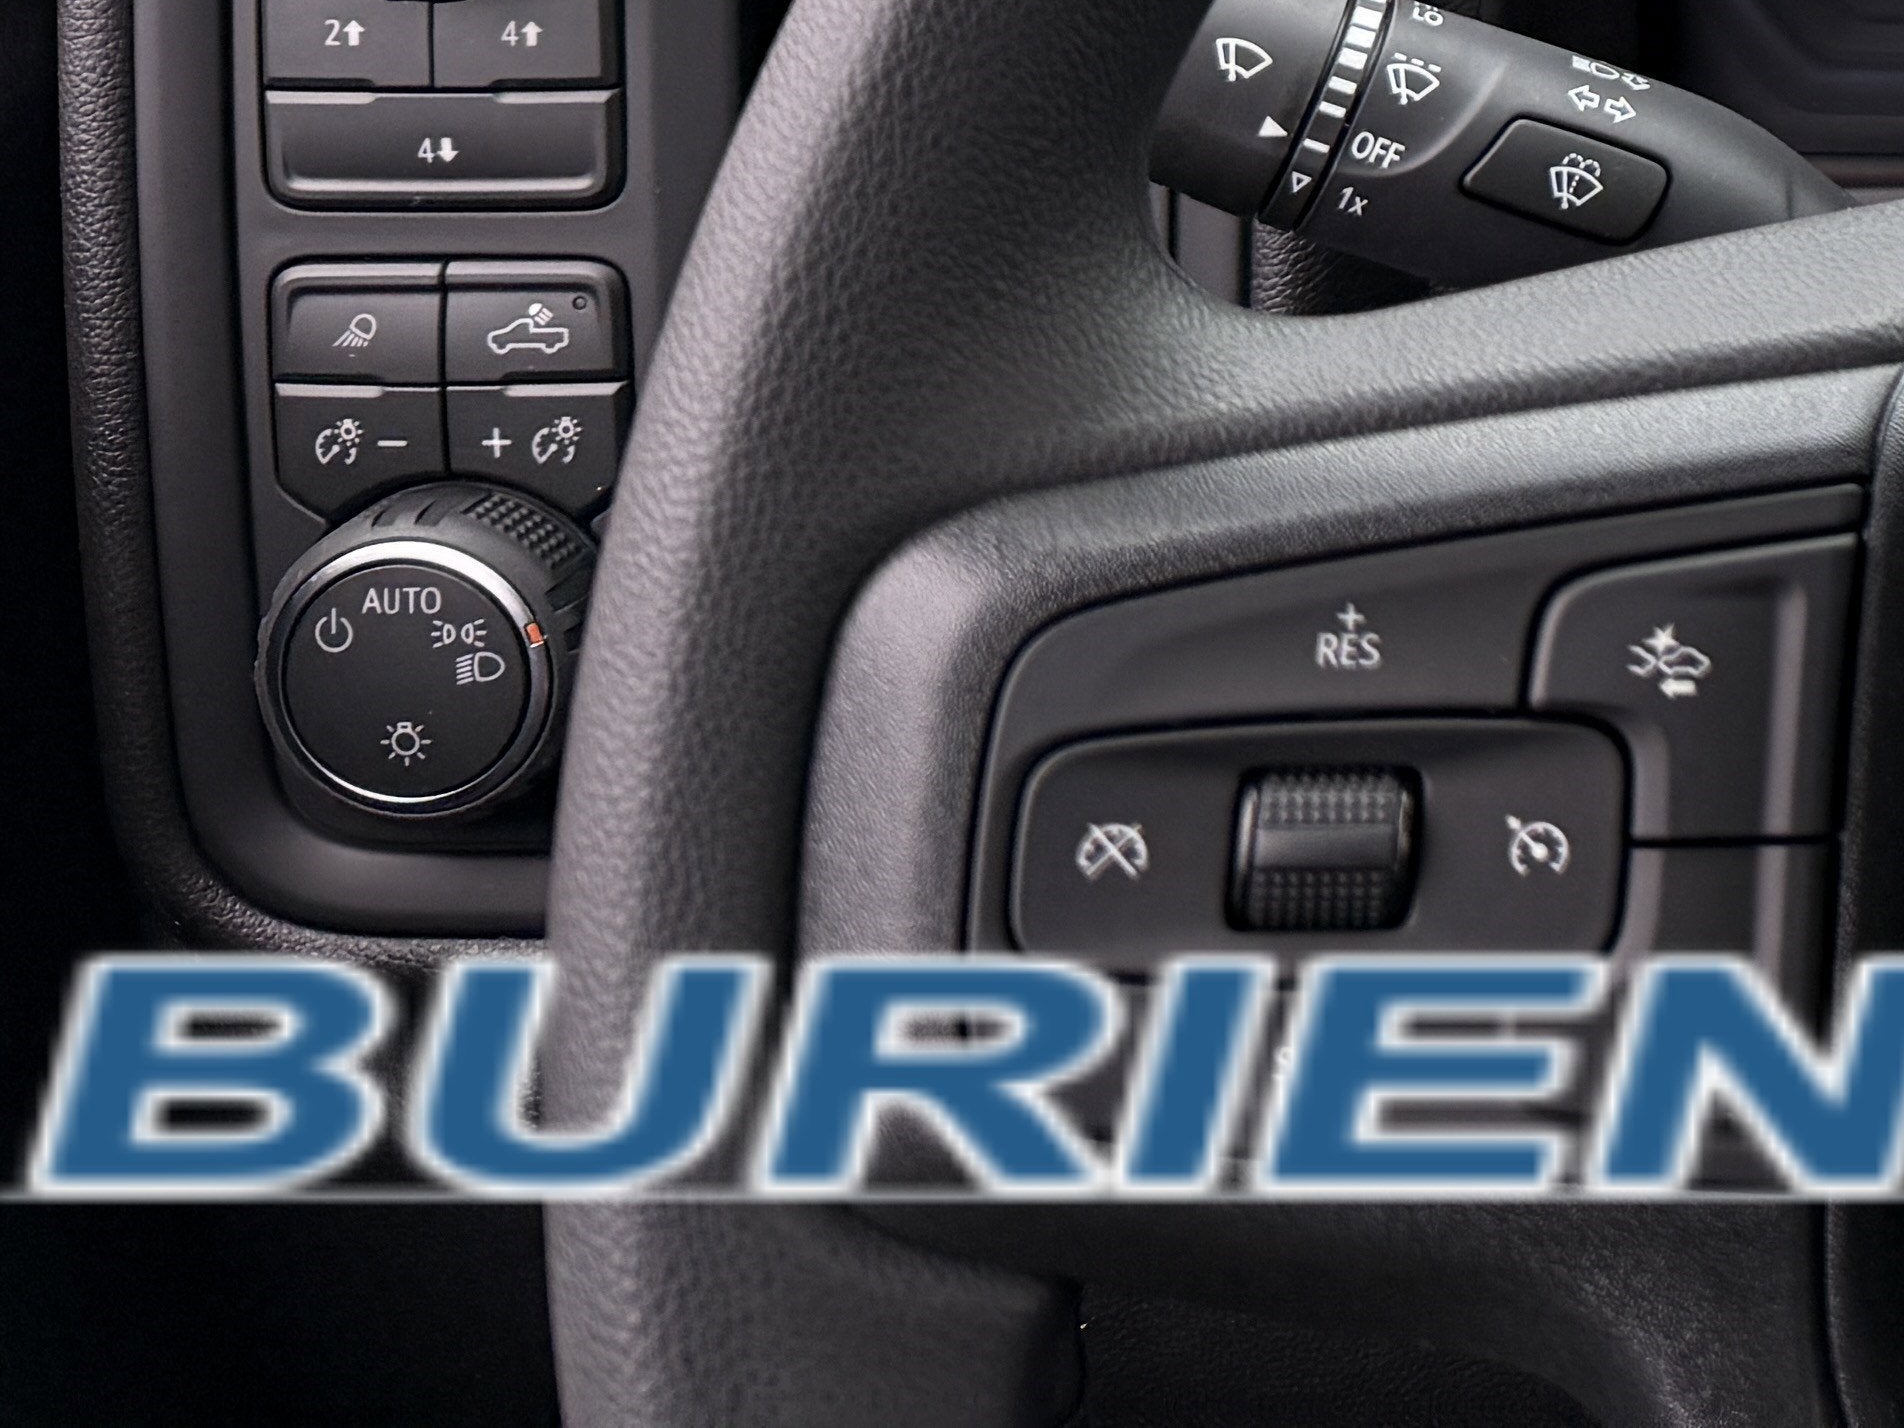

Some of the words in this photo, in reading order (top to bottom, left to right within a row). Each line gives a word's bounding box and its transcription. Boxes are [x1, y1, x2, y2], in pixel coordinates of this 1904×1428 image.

[325, 20, 340, 46] 2
[501, 21, 518, 46] 4
[418, 139, 434, 163] 4
[1352, 130, 1405, 169] OFF
[1336, 188, 1368, 216] 1x
[362, 587, 441, 615] AUTO
[1317, 633, 1381, 669] RES
